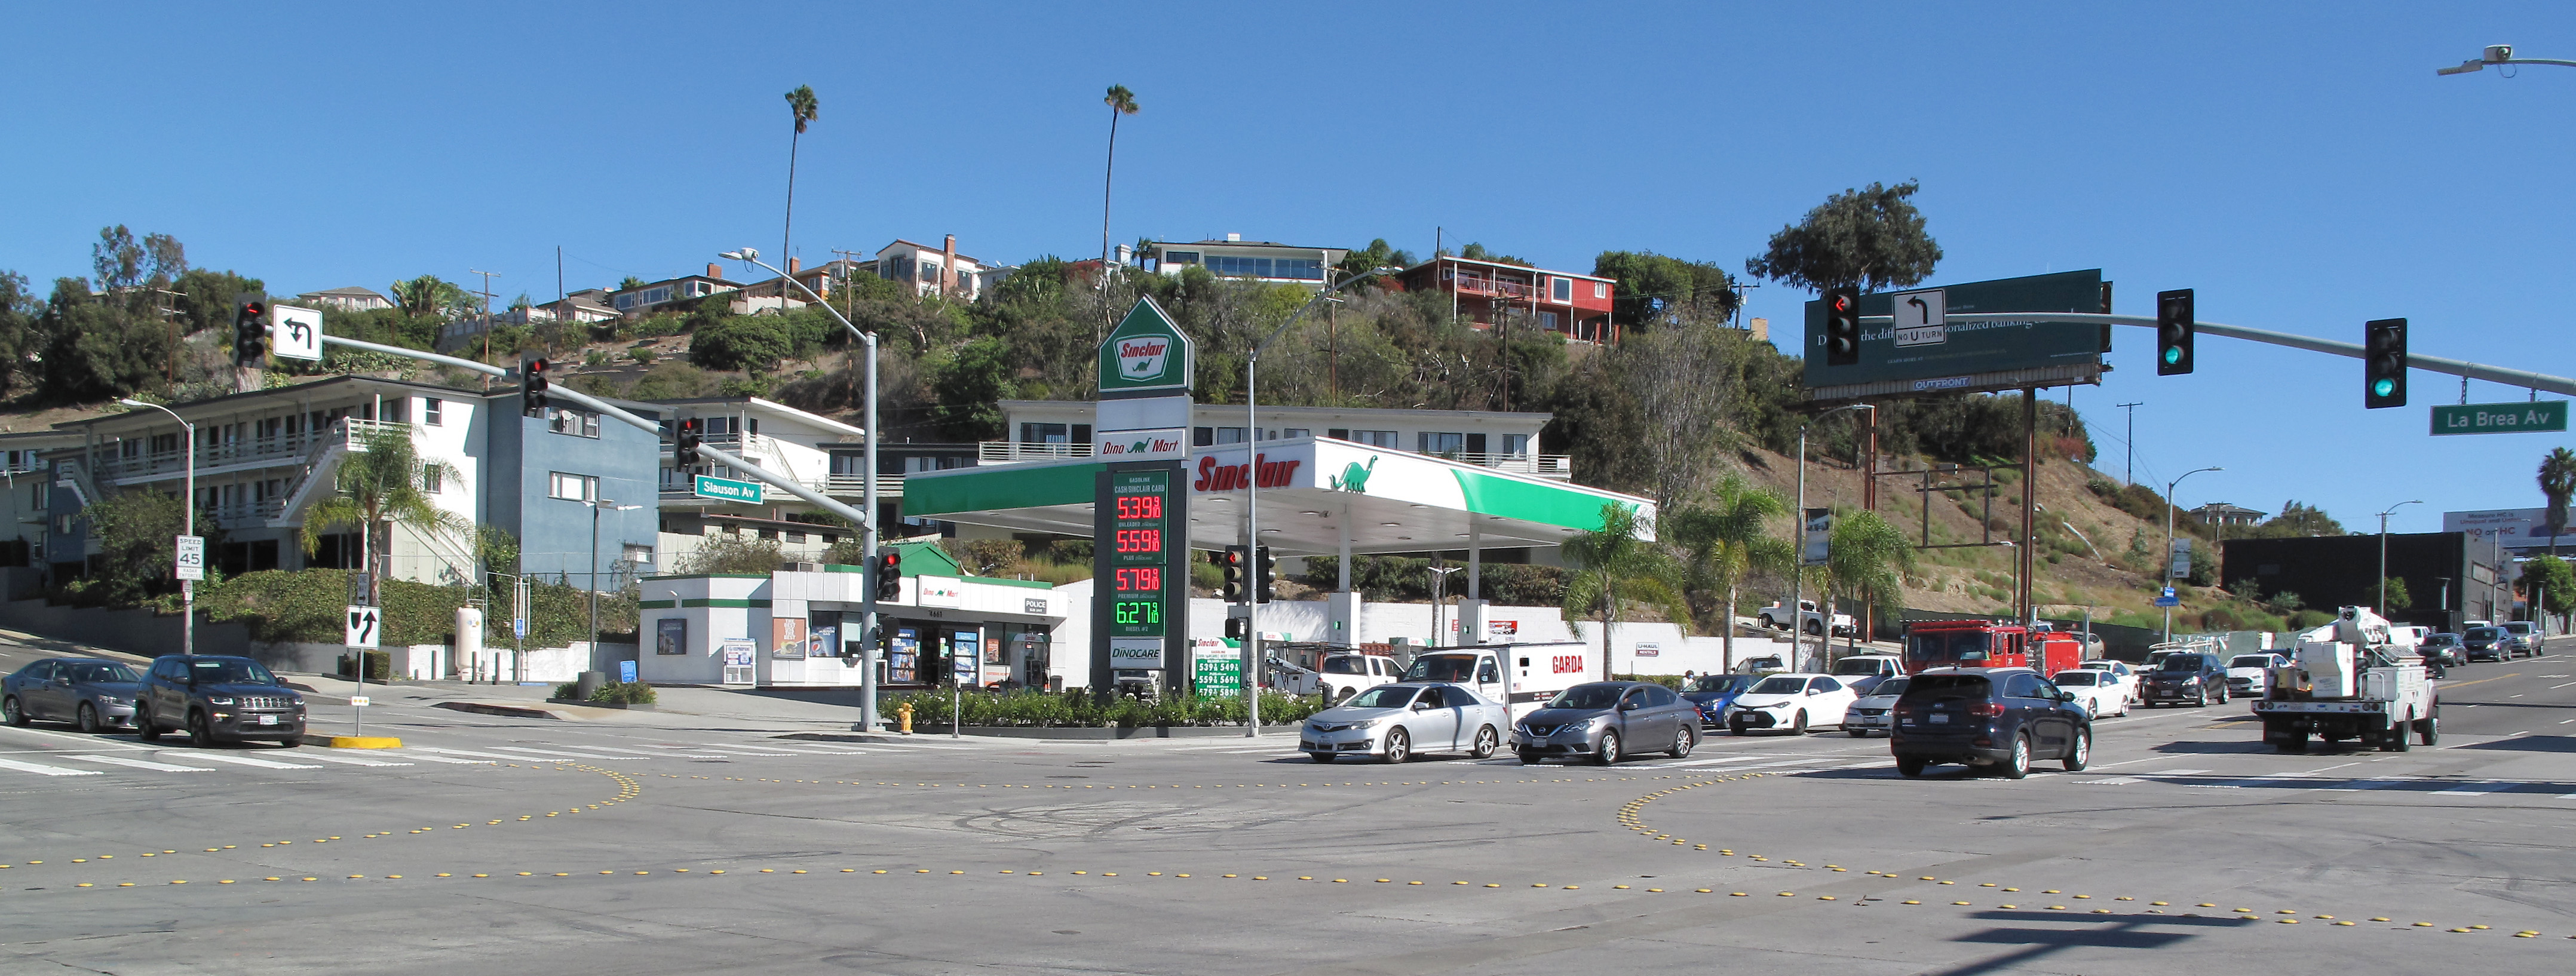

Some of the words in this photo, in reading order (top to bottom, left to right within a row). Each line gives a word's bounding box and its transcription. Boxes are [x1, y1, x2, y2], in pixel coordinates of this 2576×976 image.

[1861, 330, 1876, 341] the
[1910, 332, 1918, 341] U
[1922, 330, 1942, 339] TURN
[1121, 341, 1166, 358] Sinclair
[1915, 377, 1968, 389] OUTFRONT
[2448, 413, 2468, 427] La
[2476, 412, 2517, 426] Brea
[2524, 409, 2550, 425] Av
[1103, 441, 1124, 455] Dino
[1152, 439, 1179, 453] Mart
[1194, 453, 1301, 492] Sinclair
[704, 481, 740, 496] Slauson
[741, 487, 755, 498] Av
[1117, 496, 1152, 519] 5.39
[1117, 529, 1152, 553] 5.59
[179, 553, 200, 564] 45
[1116, 568, 1151, 591] 5.79
[1116, 601, 1151, 624] 6.27
[1198, 639, 1219, 647] Sinclair
[1553, 655, 1583, 674] GARDA
